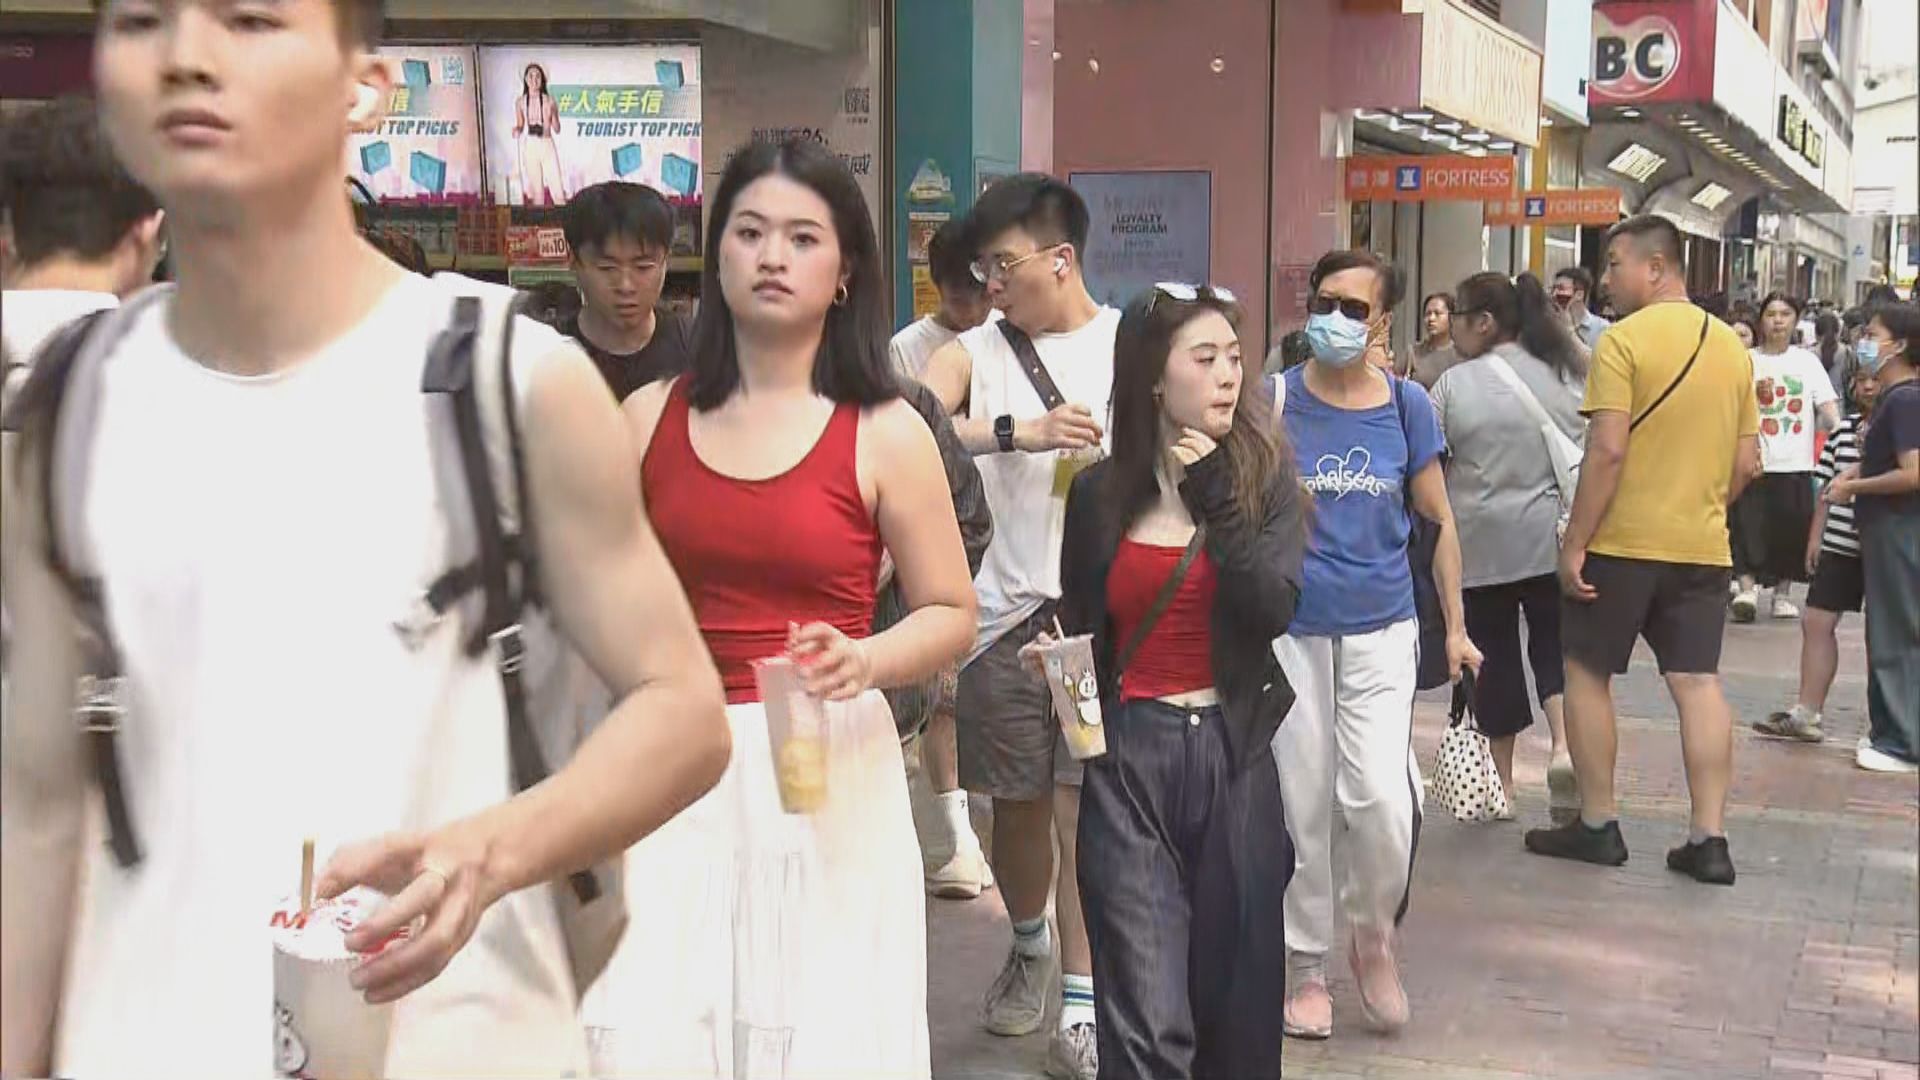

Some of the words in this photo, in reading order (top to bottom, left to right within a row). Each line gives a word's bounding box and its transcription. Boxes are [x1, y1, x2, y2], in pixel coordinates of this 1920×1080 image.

[559, 89, 664, 113] #人氣手信
[388, 120, 416, 135] TOP
[416, 120, 460, 135] PICKS
[577, 122, 638, 136] TOURIST
[641, 122, 668, 136] TOP
[1426, 168, 1510, 185] FORTRESS
[1549, 198, 1617, 213] FORTRESS
[1116, 214, 1163, 223] LOYALTY
[1111, 224, 1168, 235] PROGRAM
